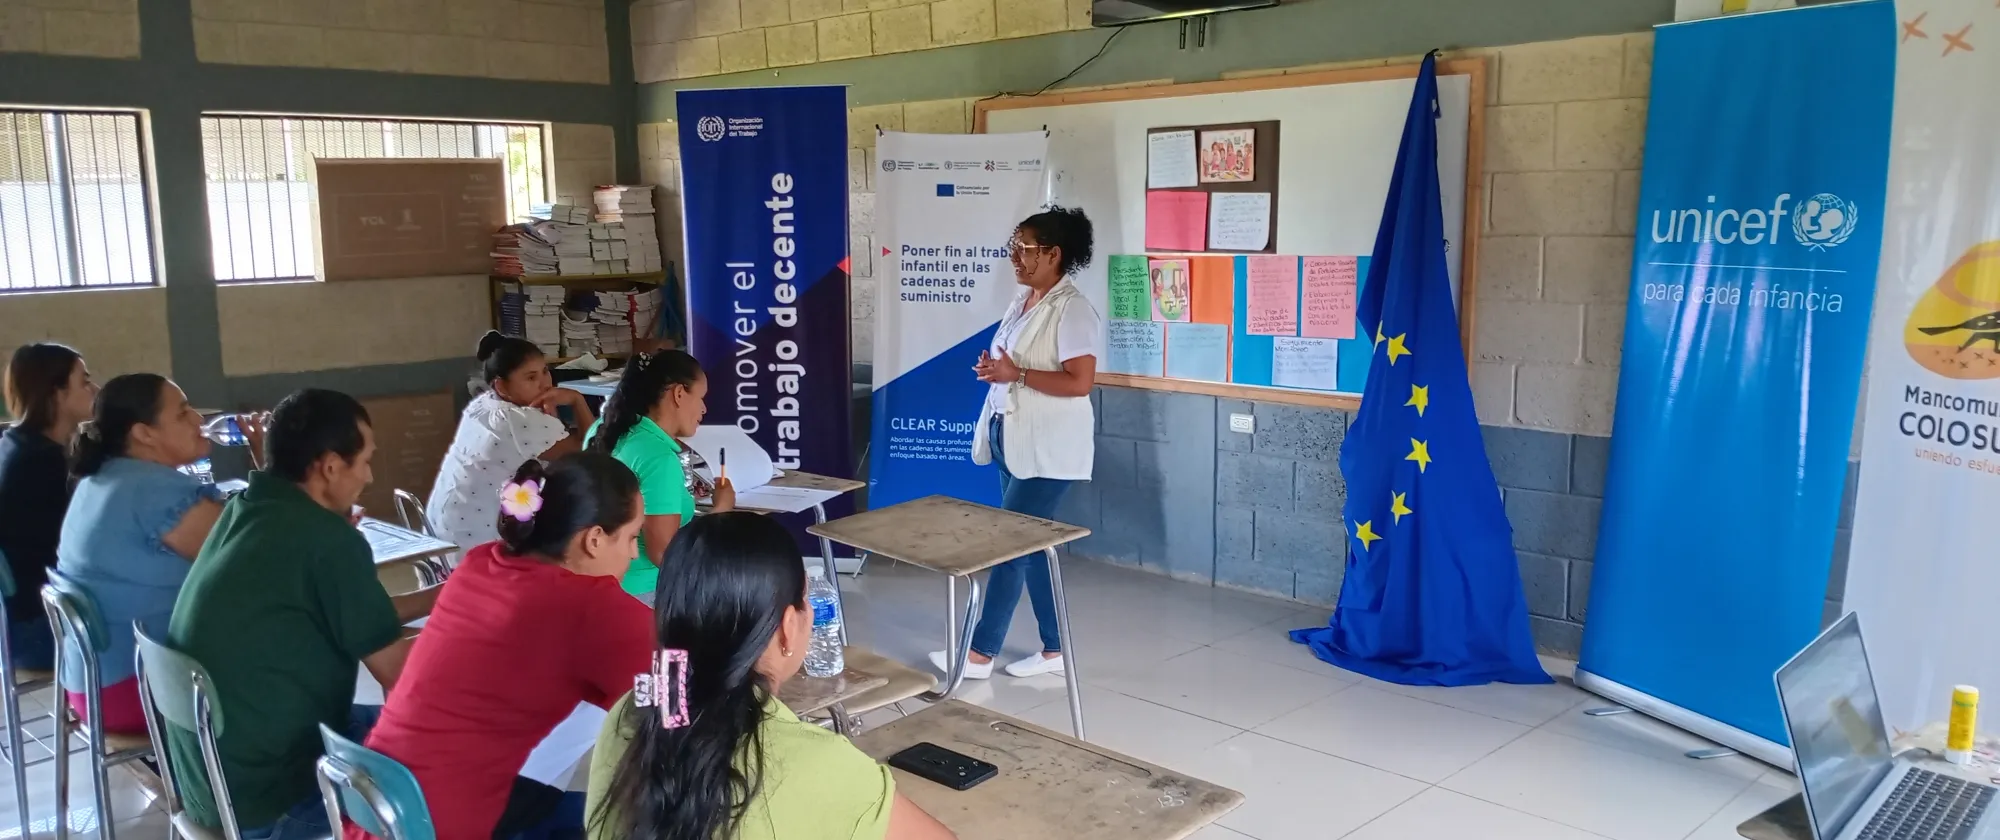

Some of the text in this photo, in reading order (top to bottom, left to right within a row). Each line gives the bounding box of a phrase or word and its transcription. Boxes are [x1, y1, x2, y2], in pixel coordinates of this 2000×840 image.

[1651, 193, 1791, 245] unicef
[901, 244, 941, 257] Poner
[945, 245, 961, 258] fin
[965, 246, 977, 258] al
[901, 259, 990, 273] infantil en las
[901, 275, 975, 288] cadenas de
[900, 290, 971, 303] suministro
[1643, 281, 1843, 313] para cada infancia
[764, 172, 807, 470] trabajo decente
[725, 262, 759, 433] omover el
[1904, 384, 2000, 418] Mancomu
[890, 417, 976, 435] CLEAR Suppl
[947, 438, 972, 446] profund
[890, 452, 915, 460] enfoque
[1915, 447, 1962, 466] uniendo
